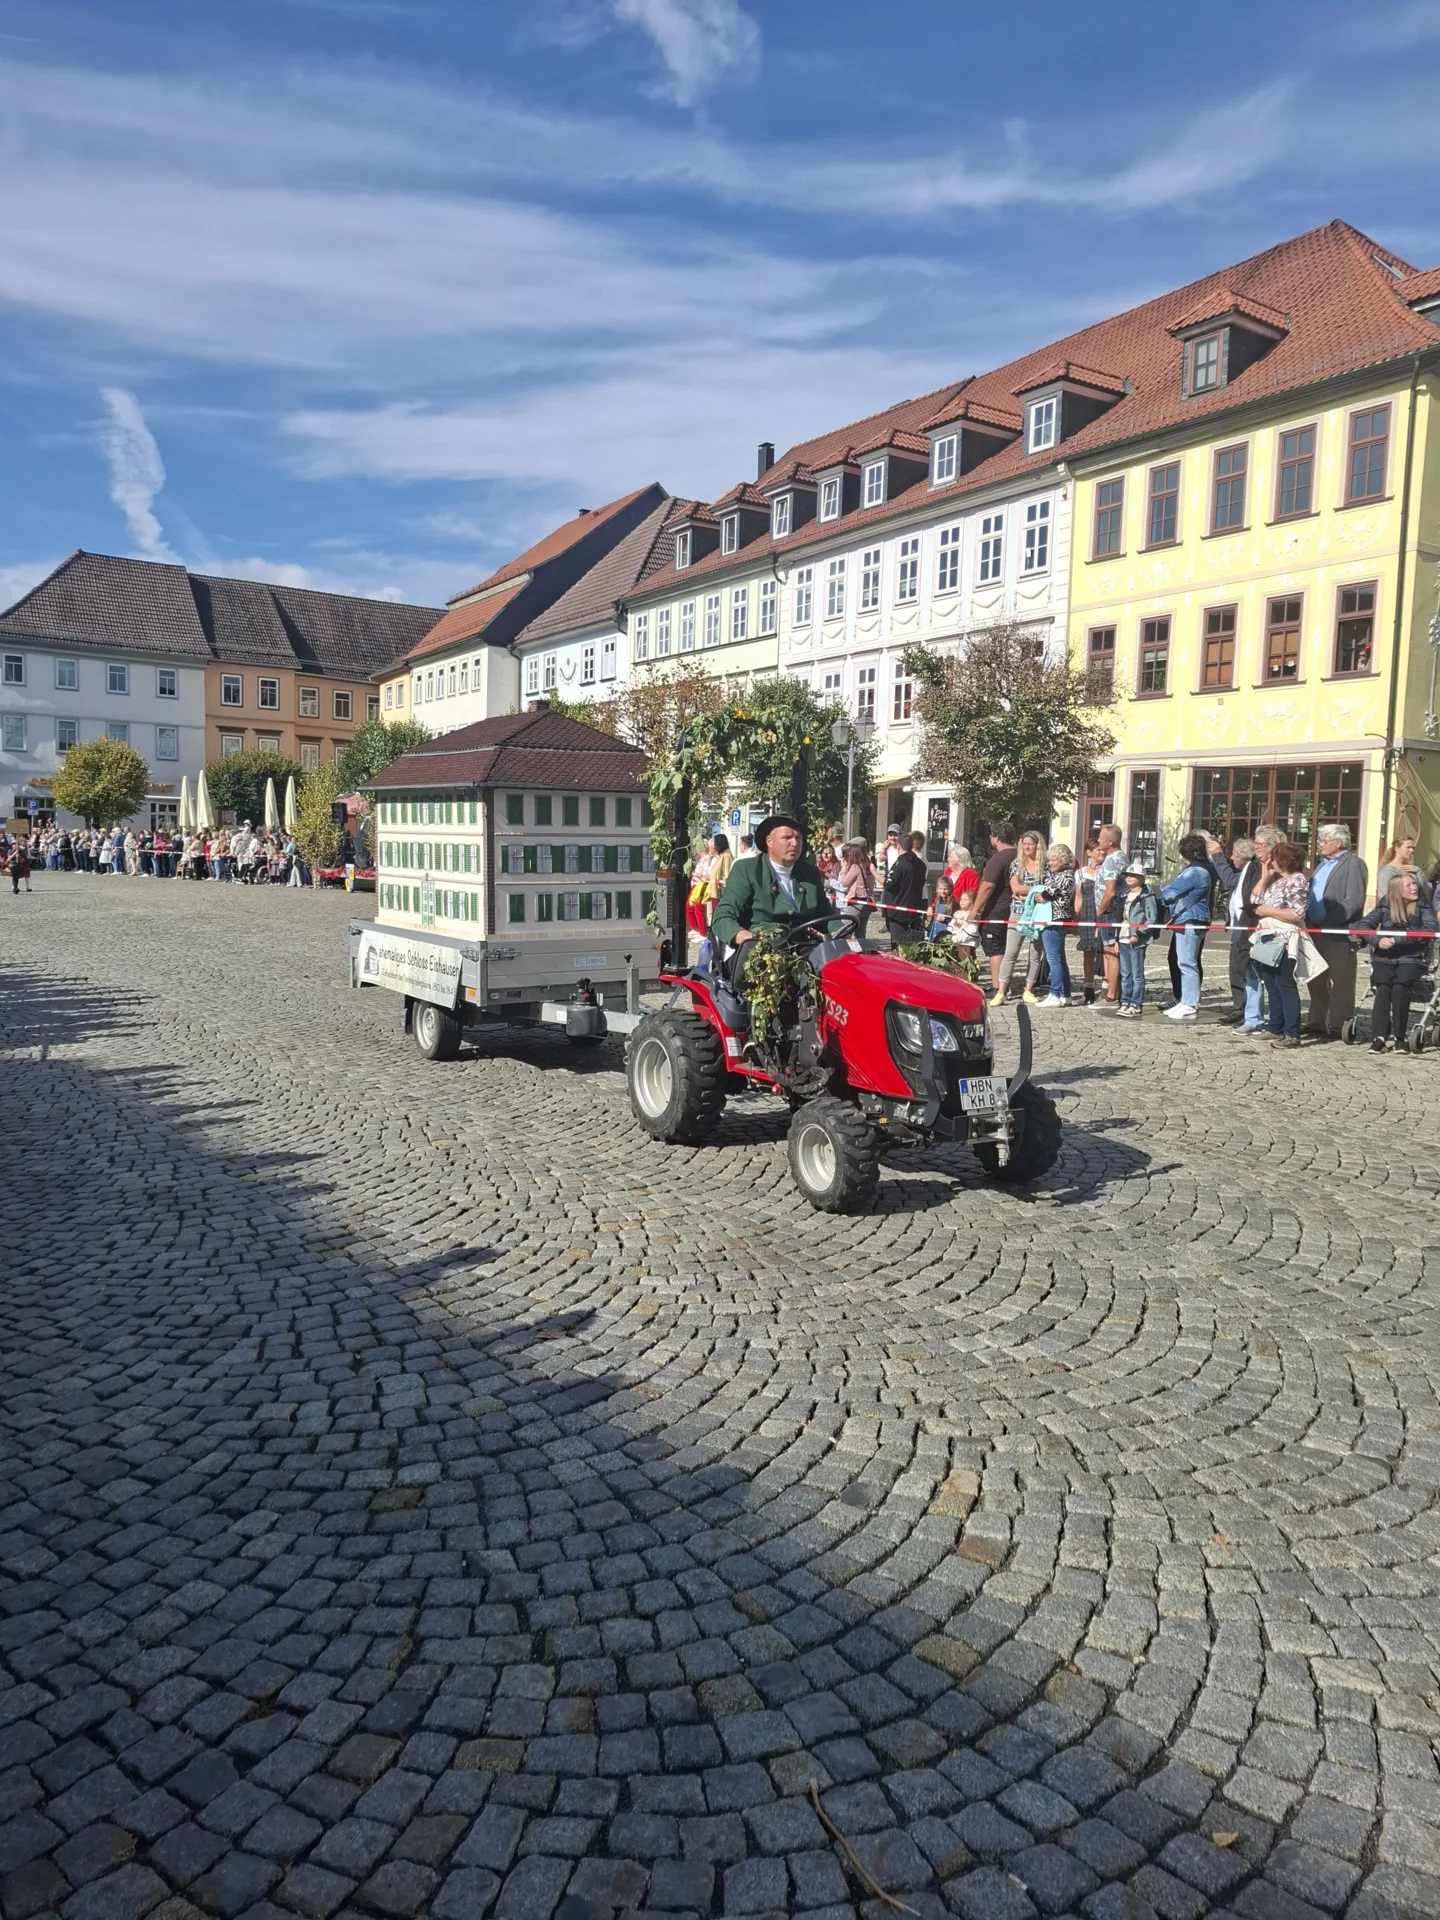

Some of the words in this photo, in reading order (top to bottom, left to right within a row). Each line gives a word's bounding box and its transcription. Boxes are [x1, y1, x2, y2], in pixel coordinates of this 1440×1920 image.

[379, 944, 406, 967] ehemaliges
[407, 949, 429, 970] Schloss
[970, 1079, 993, 1094] HBN
[970, 1094, 986, 1108] KH
[989, 1093, 996, 1106] 8
